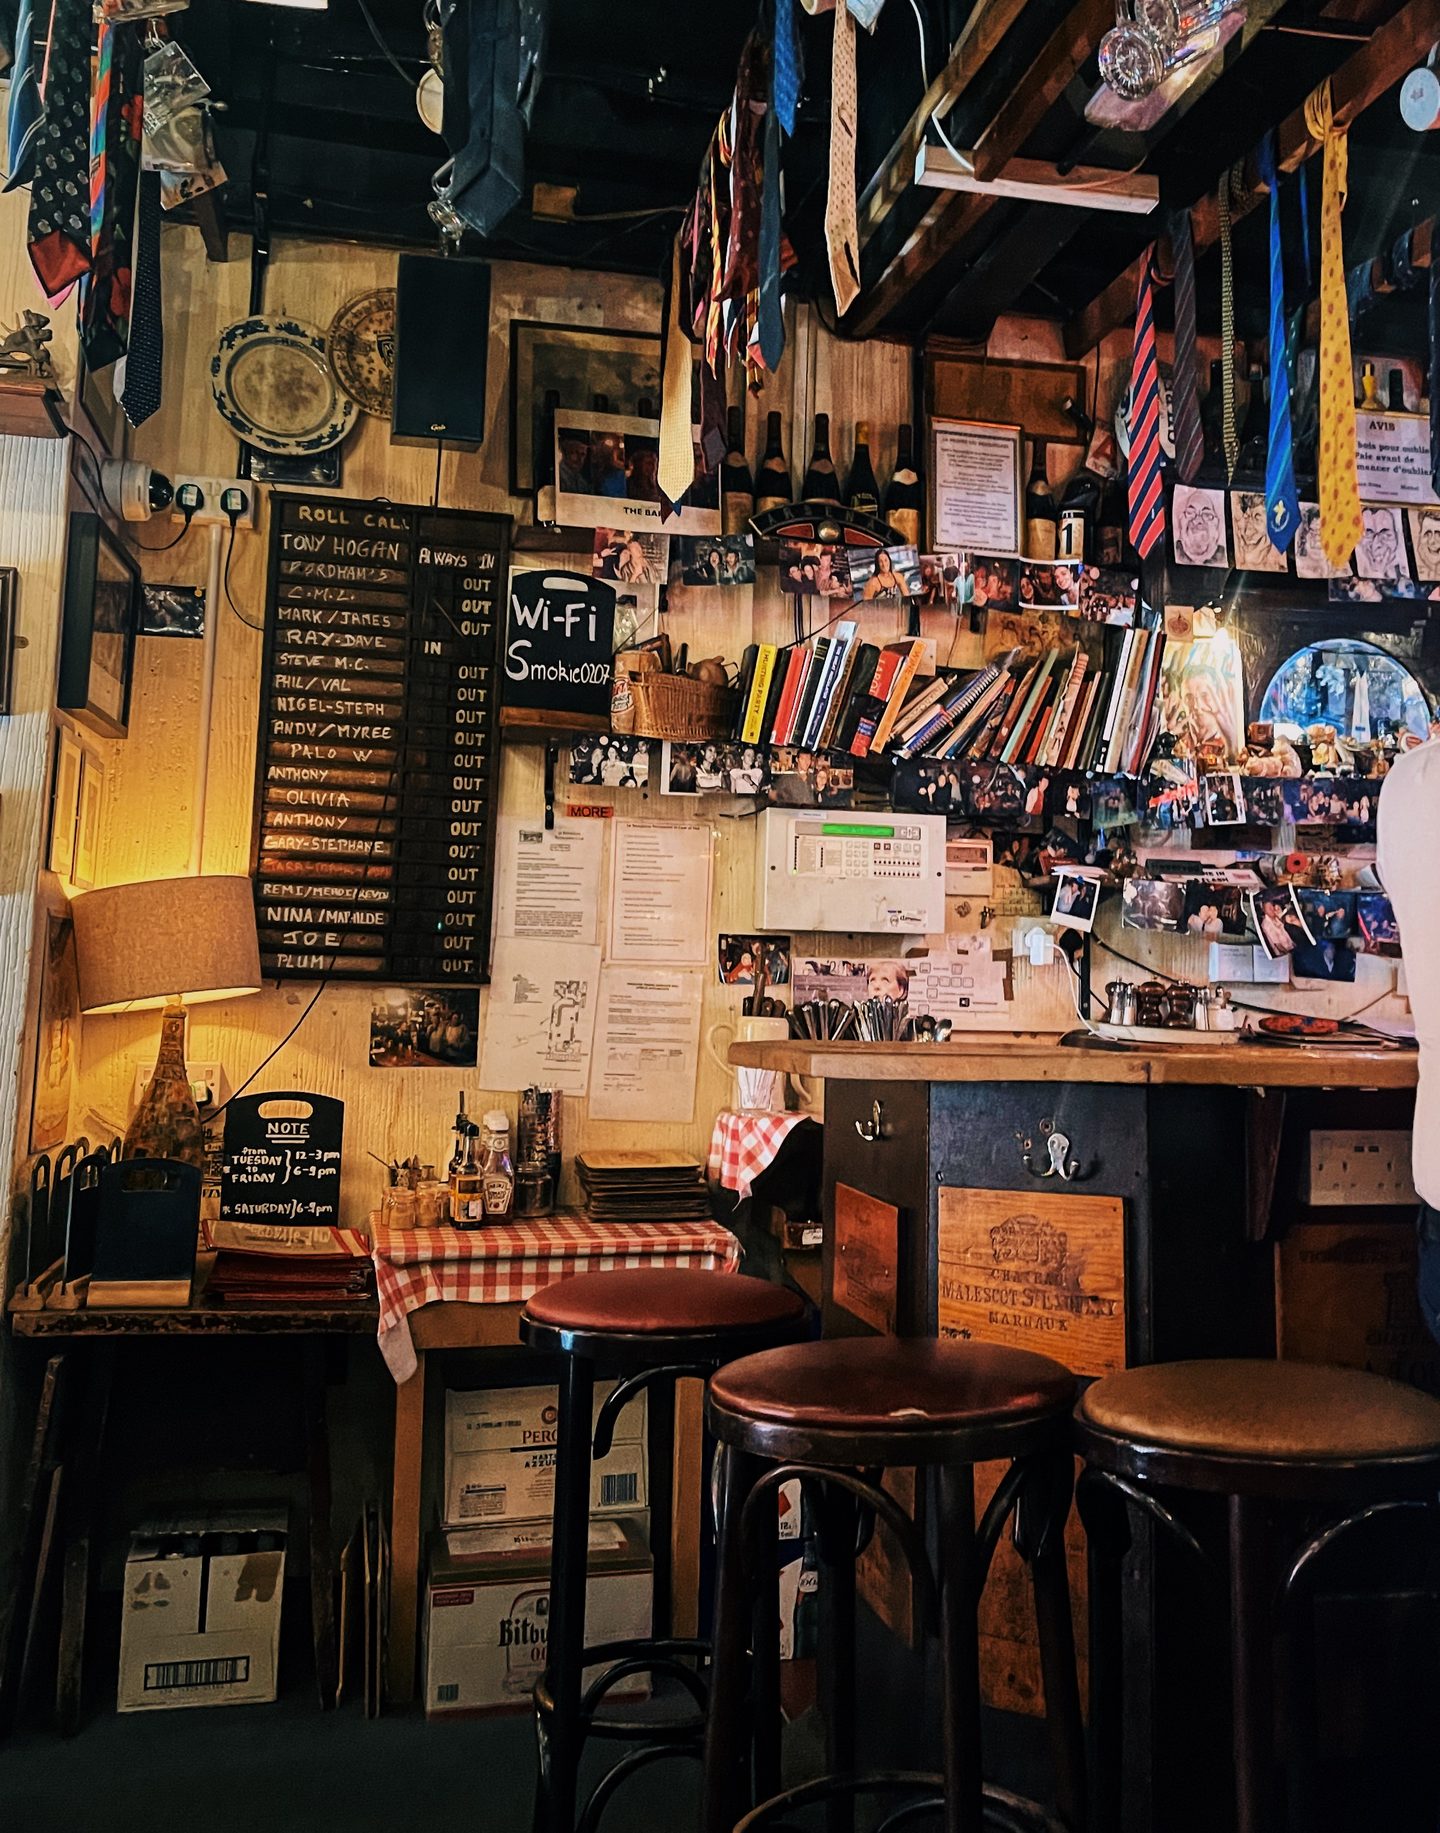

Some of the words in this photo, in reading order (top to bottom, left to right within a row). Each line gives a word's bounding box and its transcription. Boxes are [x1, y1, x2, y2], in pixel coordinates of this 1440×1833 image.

[1369, 420, 1395, 431] AVIS
[1402, 445, 1430, 454] oublie
[299, 505, 349, 525] ROLL
[364, 514, 410, 530] CALL
[623, 507, 642, 516] THE
[280, 533, 326, 551] TONY
[333, 538, 399, 561] HOGAN
[478, 553, 495, 569] IN
[463, 578, 491, 593] OUT
[461, 600, 492, 615] OUT
[511, 594, 597, 642] Wi-Fi
[460, 621, 491, 636] OUT
[424, 641, 442, 655] IN
[280, 653, 324, 667] STEVE
[458, 665, 489, 680] OUT
[457, 688, 487, 702] OUT
[277, 697, 385, 716] NIGEL-STEPH
[455, 709, 486, 724] OUT
[454, 732, 485, 746] OUT
[454, 754, 485, 769] OUT
[267, 766, 329, 781] ANTHONY
[453, 776, 484, 791] OUT
[286, 790, 351, 808] OLIVIA
[451, 799, 482, 814] OUT
[570, 806, 609, 818] MORE
[273, 812, 348, 829] ANTHONY
[450, 822, 482, 837] OUT
[448, 867, 479, 882] OUT
[447, 890, 477, 905] OUT
[445, 912, 475, 927] OUT
[283, 931, 340, 947] JOE
[443, 935, 474, 950] OUT
[277, 953, 324, 969] PLUM
[442, 959, 471, 973] OUT
[267, 1122, 310, 1135] NOTE
[241, 1146, 267, 1155] from
[231, 1155, 283, 1166] TUESDAY
[246, 1165, 258, 1174] to
[231, 1172, 276, 1184] FRIDAY
[234, 1203, 292, 1215] SATURDAY
[522, 1429, 557, 1445] PER
[498, 1617, 549, 1647] Bitbu
